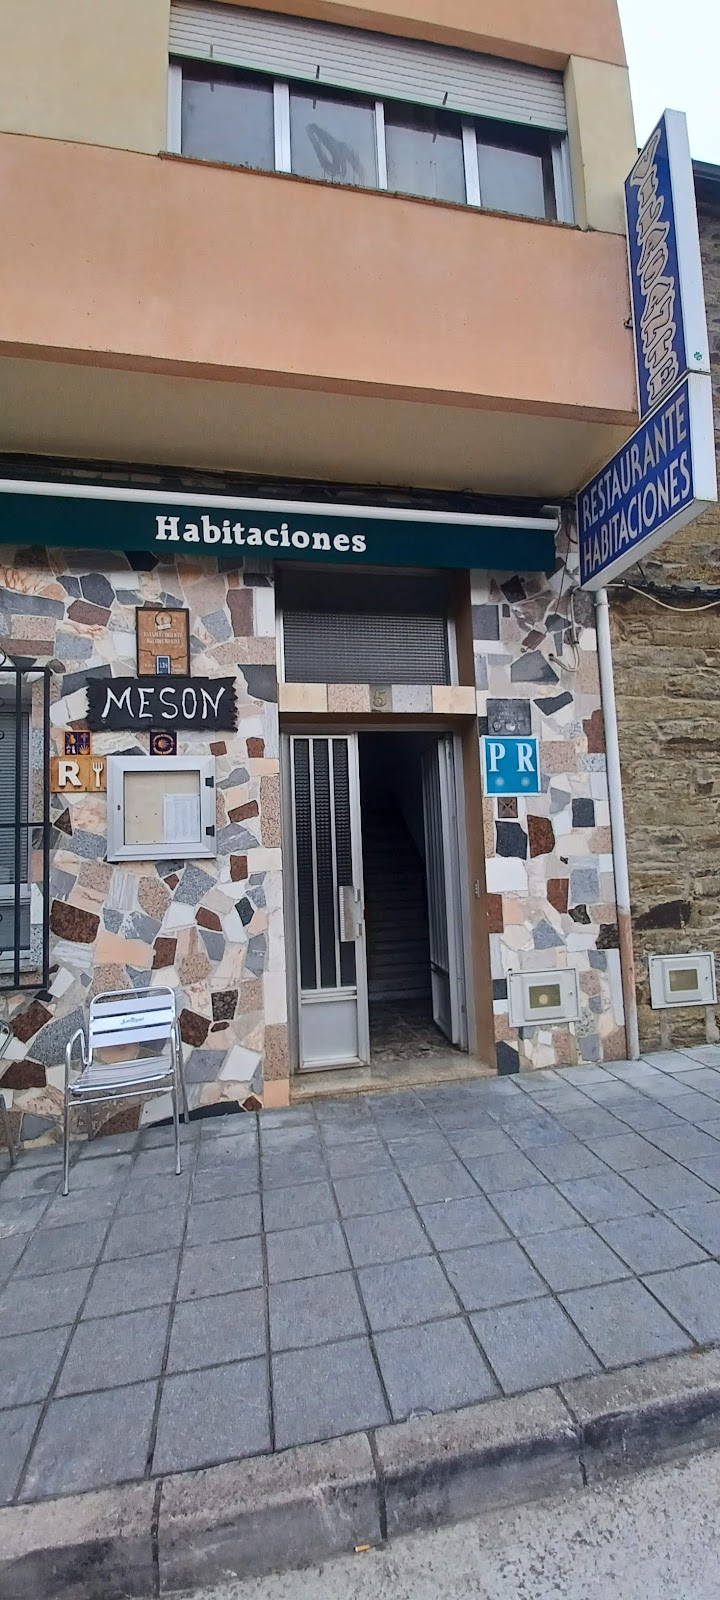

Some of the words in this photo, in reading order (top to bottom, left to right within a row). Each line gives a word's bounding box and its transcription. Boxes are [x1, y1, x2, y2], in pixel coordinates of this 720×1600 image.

[631, 128, 677, 407] VILASANTE
[583, 394, 688, 525] RESTAURANTE
[583, 453, 691, 575] HABITACIONES
[155, 515, 367, 552] Habitaciones
[101, 687, 225, 719] MESON
[372, 689, 387, 708] 5
[58, 760, 83, 787] R
[488, 742, 506, 772] P
[515, 743, 536, 772] R
